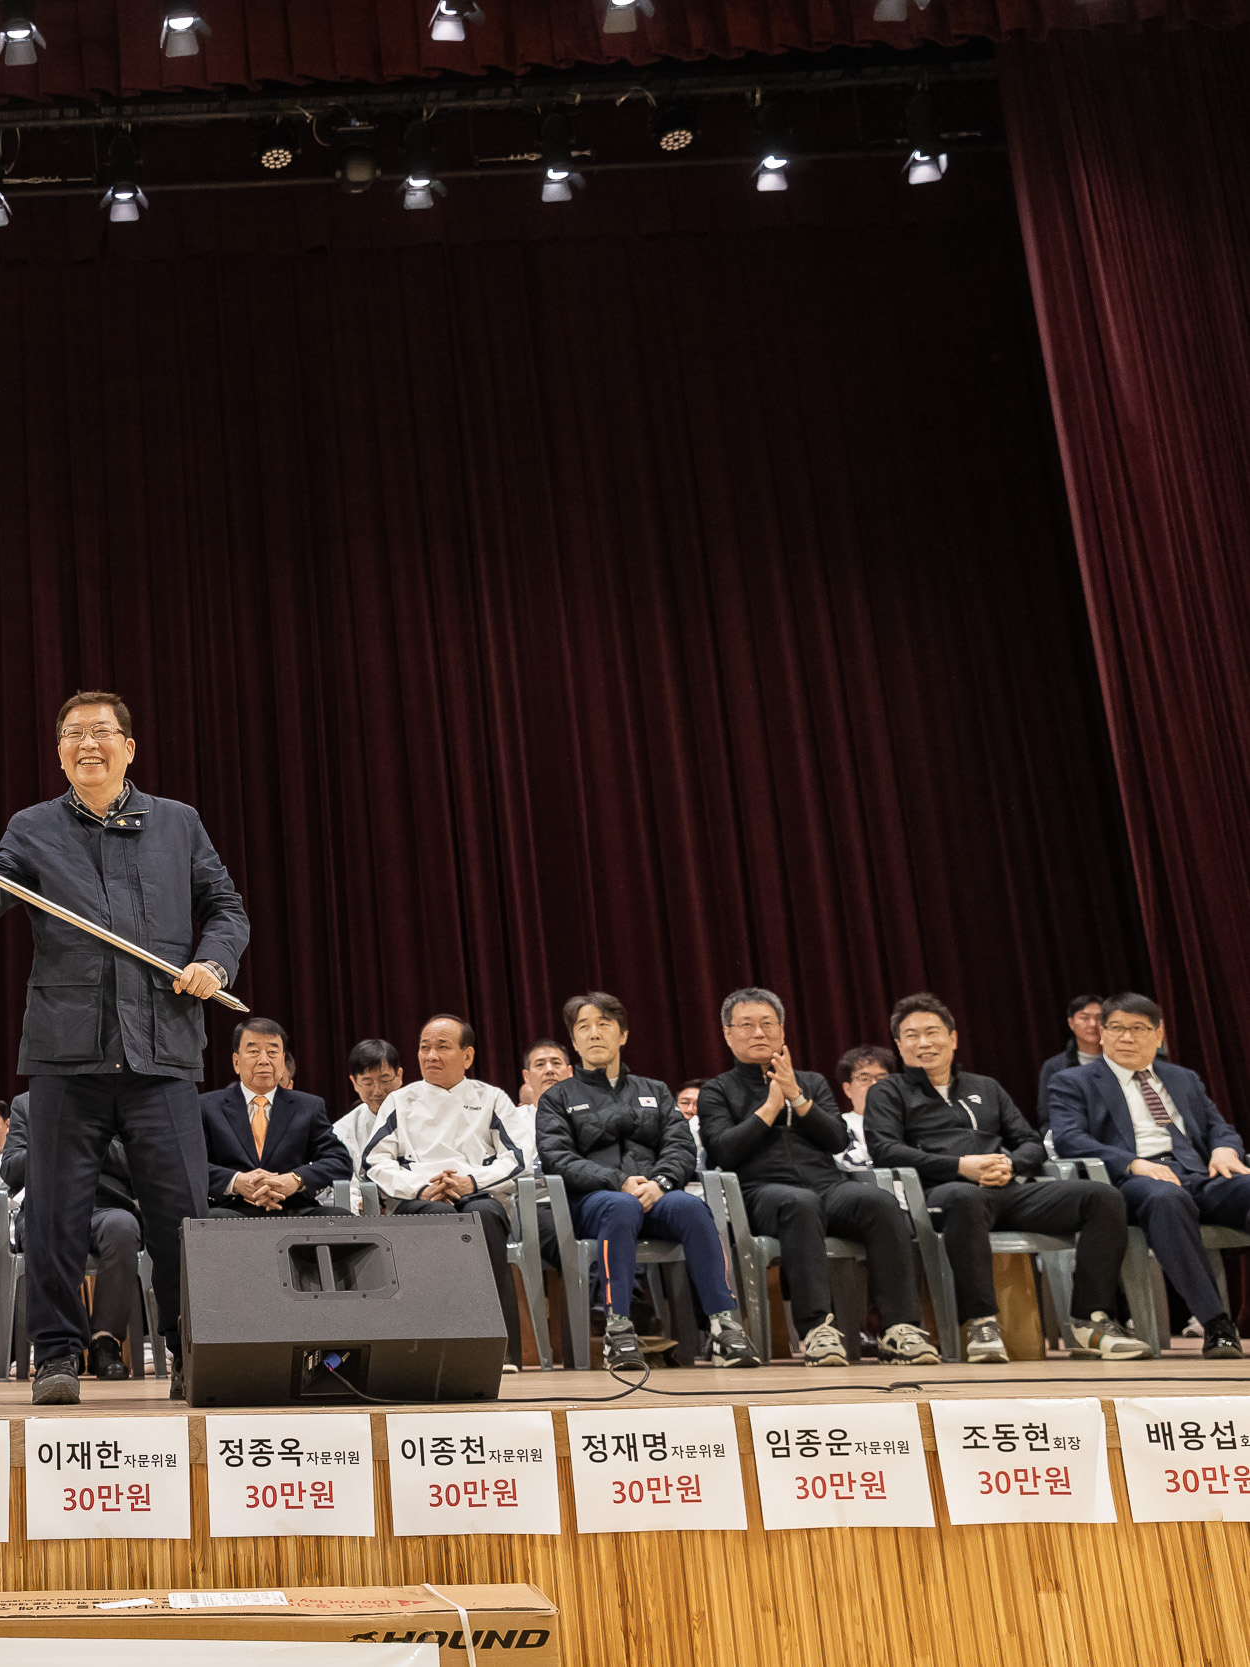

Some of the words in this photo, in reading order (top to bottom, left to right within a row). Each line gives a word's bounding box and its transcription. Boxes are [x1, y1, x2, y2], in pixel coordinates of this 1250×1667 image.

[247, 1481, 333, 1509] 30만원
[430, 1479, 518, 1507] 30만원
[613, 1475, 701, 1503] 30만원
[796, 1471, 886, 1499] 30만원
[979, 1467, 1071, 1495] 30만원
[64, 1484, 150, 1511] 30만원
